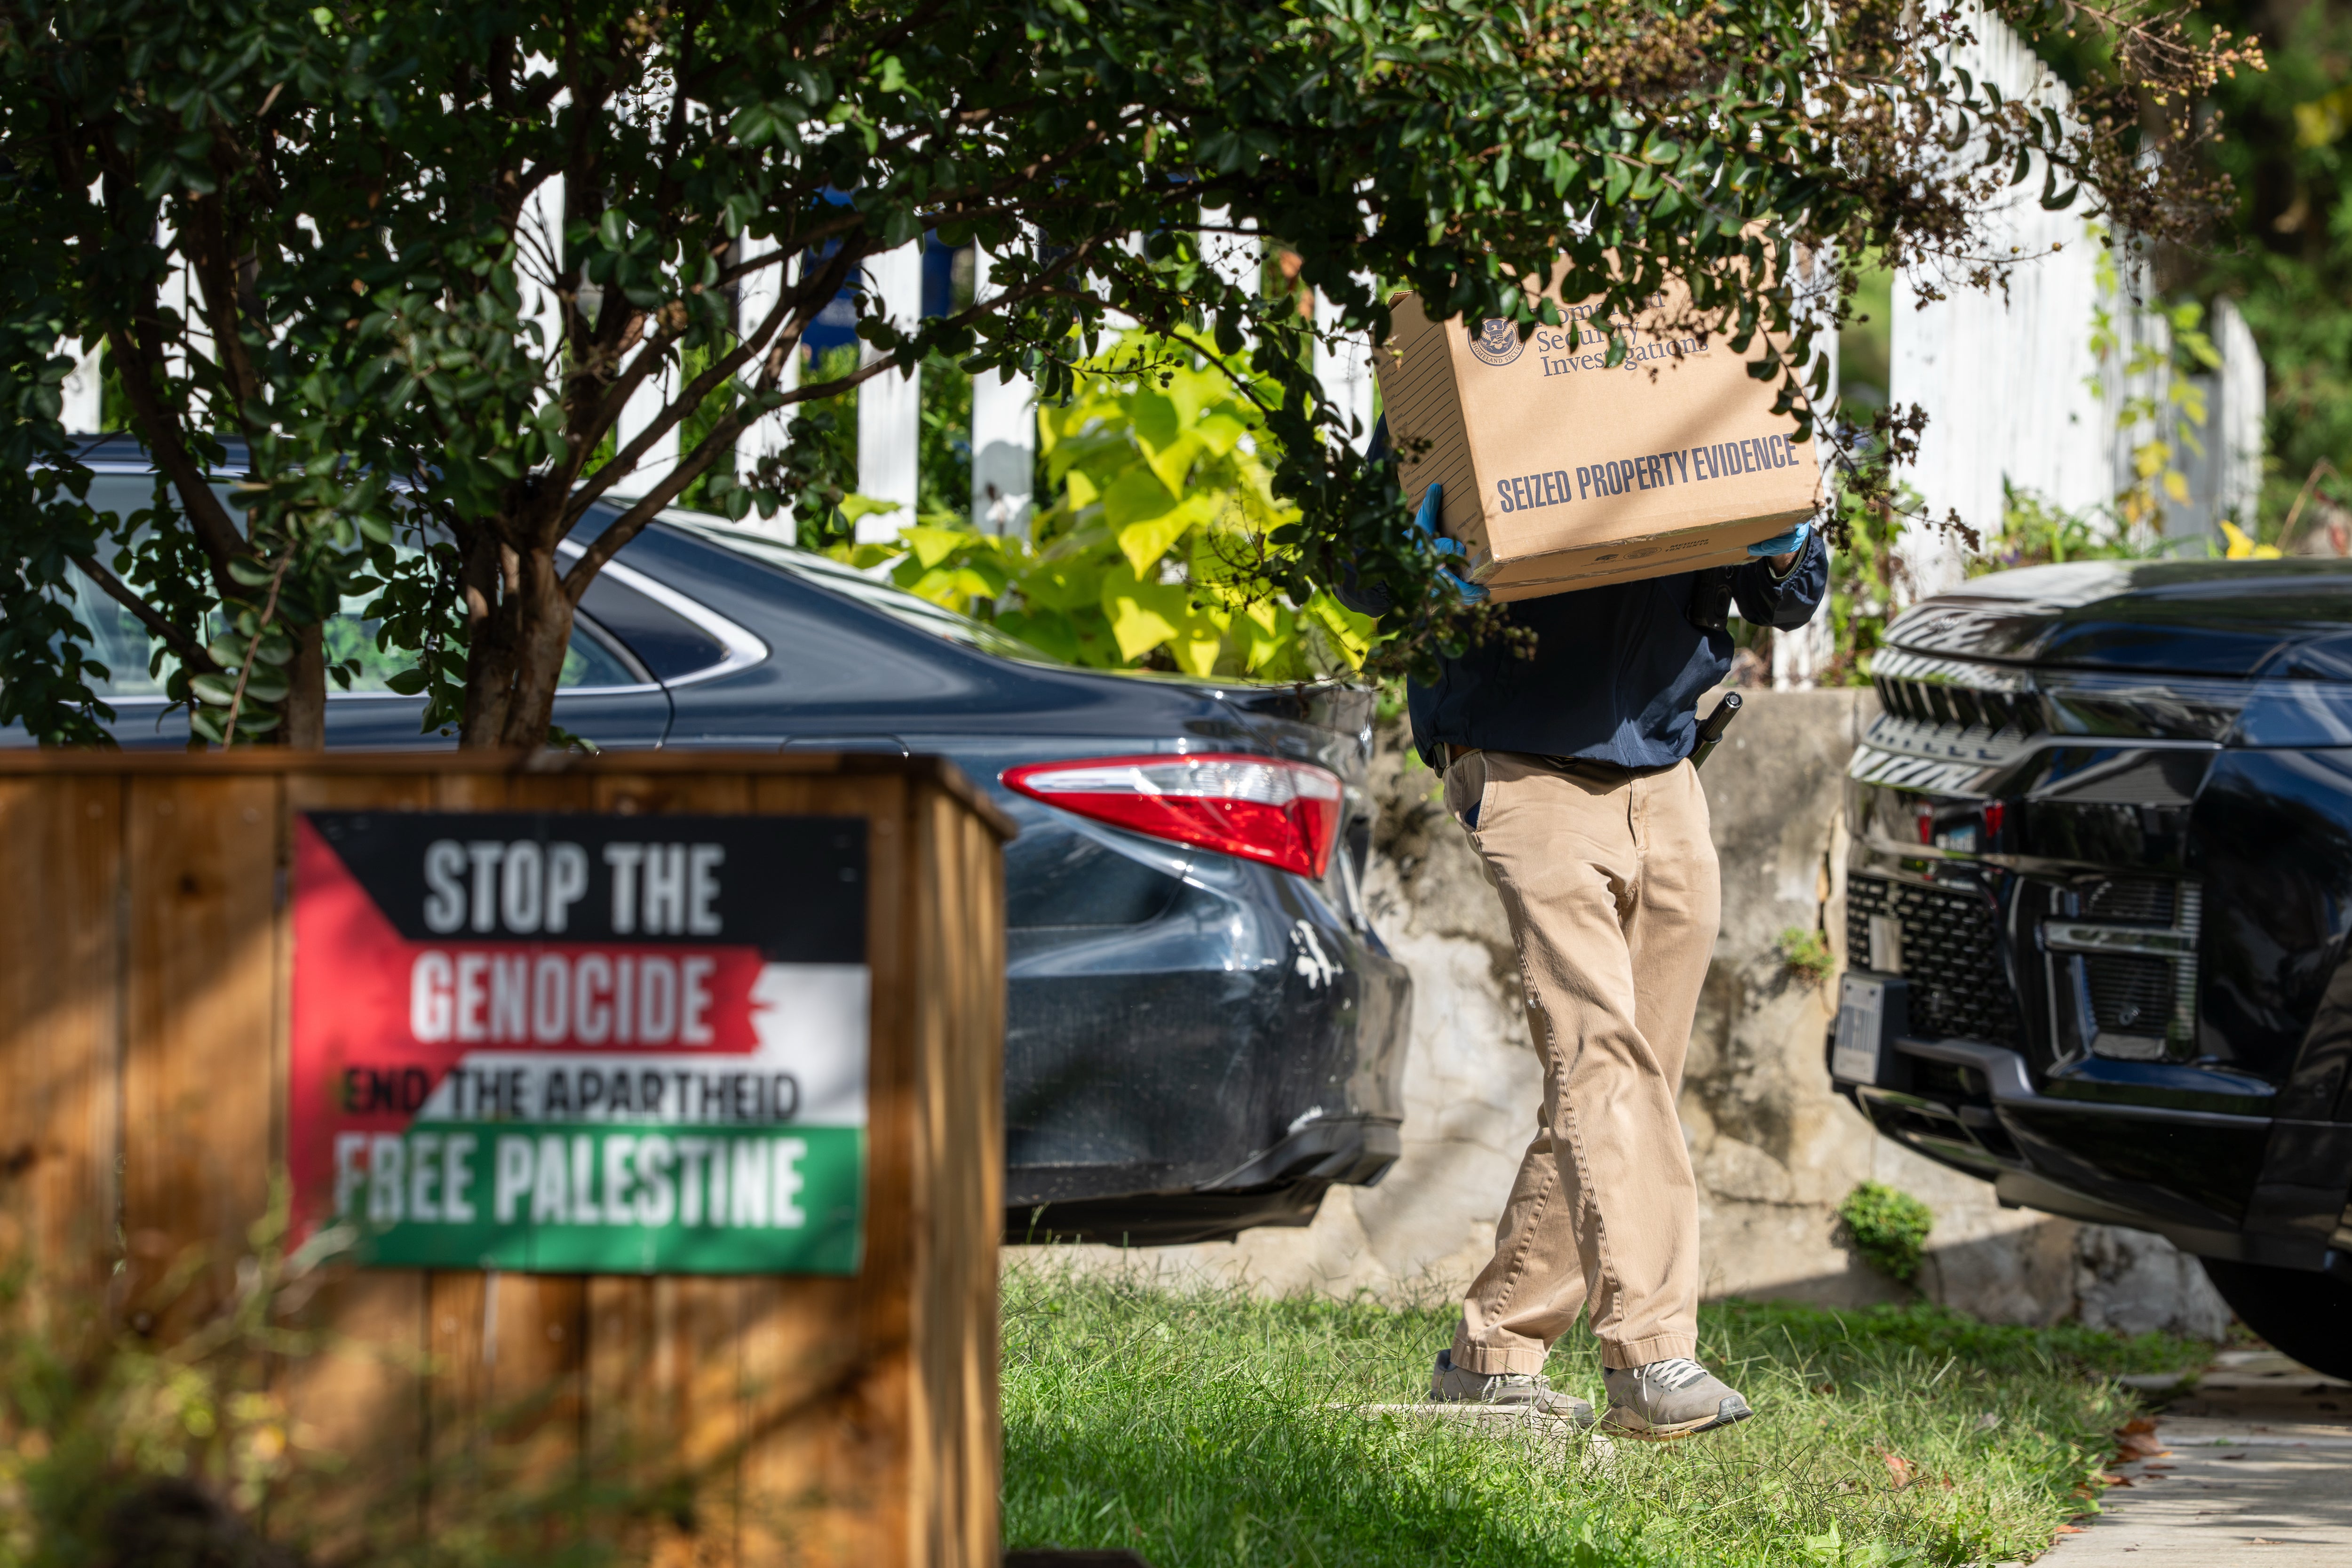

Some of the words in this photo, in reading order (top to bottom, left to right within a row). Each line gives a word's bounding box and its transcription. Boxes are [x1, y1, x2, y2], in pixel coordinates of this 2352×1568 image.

[1530, 290, 1665, 327] omed
[1472, 343, 1503, 363] HOMELAND
[1505, 339, 1523, 362] SECURIT
[1537, 319, 1640, 353] Securty
[1541, 337, 1708, 377] Invesgations
[1497, 470, 1572, 513] SEIZED
[1576, 450, 1688, 500] PROPERTY
[1691, 432, 1799, 481] EVIDENCE
[1670, 539, 1709, 549] MEDIUM
[423, 839, 588, 934] STOP
[604, 843, 725, 935] THE
[410, 950, 715, 1045] GENOCIDE
[343, 1066, 429, 1115] END
[449, 1068, 524, 1115] THE
[542, 1069, 801, 1121] APARTHEID
[334, 1132, 478, 1223] FREE
[494, 1135, 808, 1228] PALESTINE
